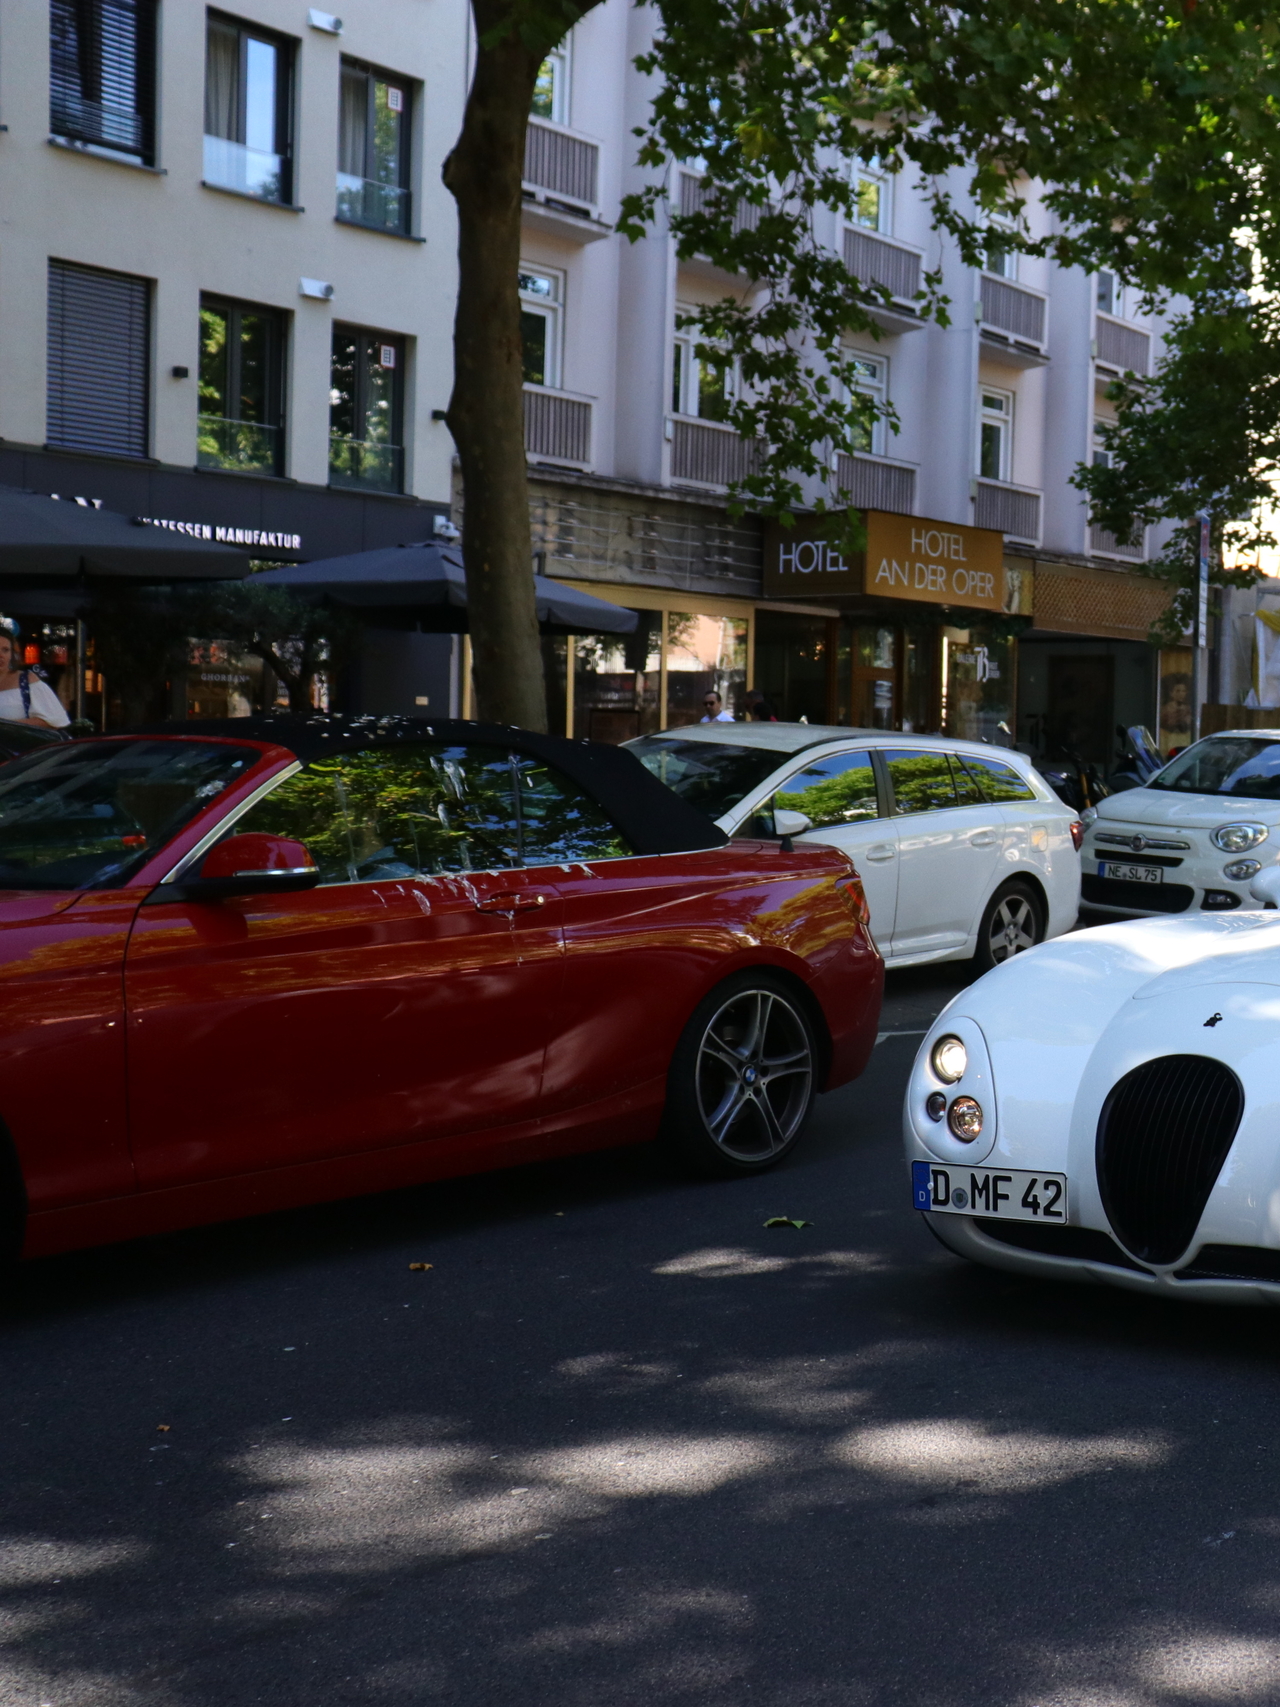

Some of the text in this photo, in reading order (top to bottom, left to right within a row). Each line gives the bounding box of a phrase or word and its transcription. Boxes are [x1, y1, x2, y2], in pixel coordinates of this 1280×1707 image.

[215, 526, 301, 549] MANUFAKTUR
[911, 527, 967, 561] HOTEL
[779, 540, 849, 574] HOTEL
[875, 557, 994, 598] AN DER OPER
[1108, 865, 1158, 882] NE SL 75
[931, 1169, 1063, 1217] D MF 42
